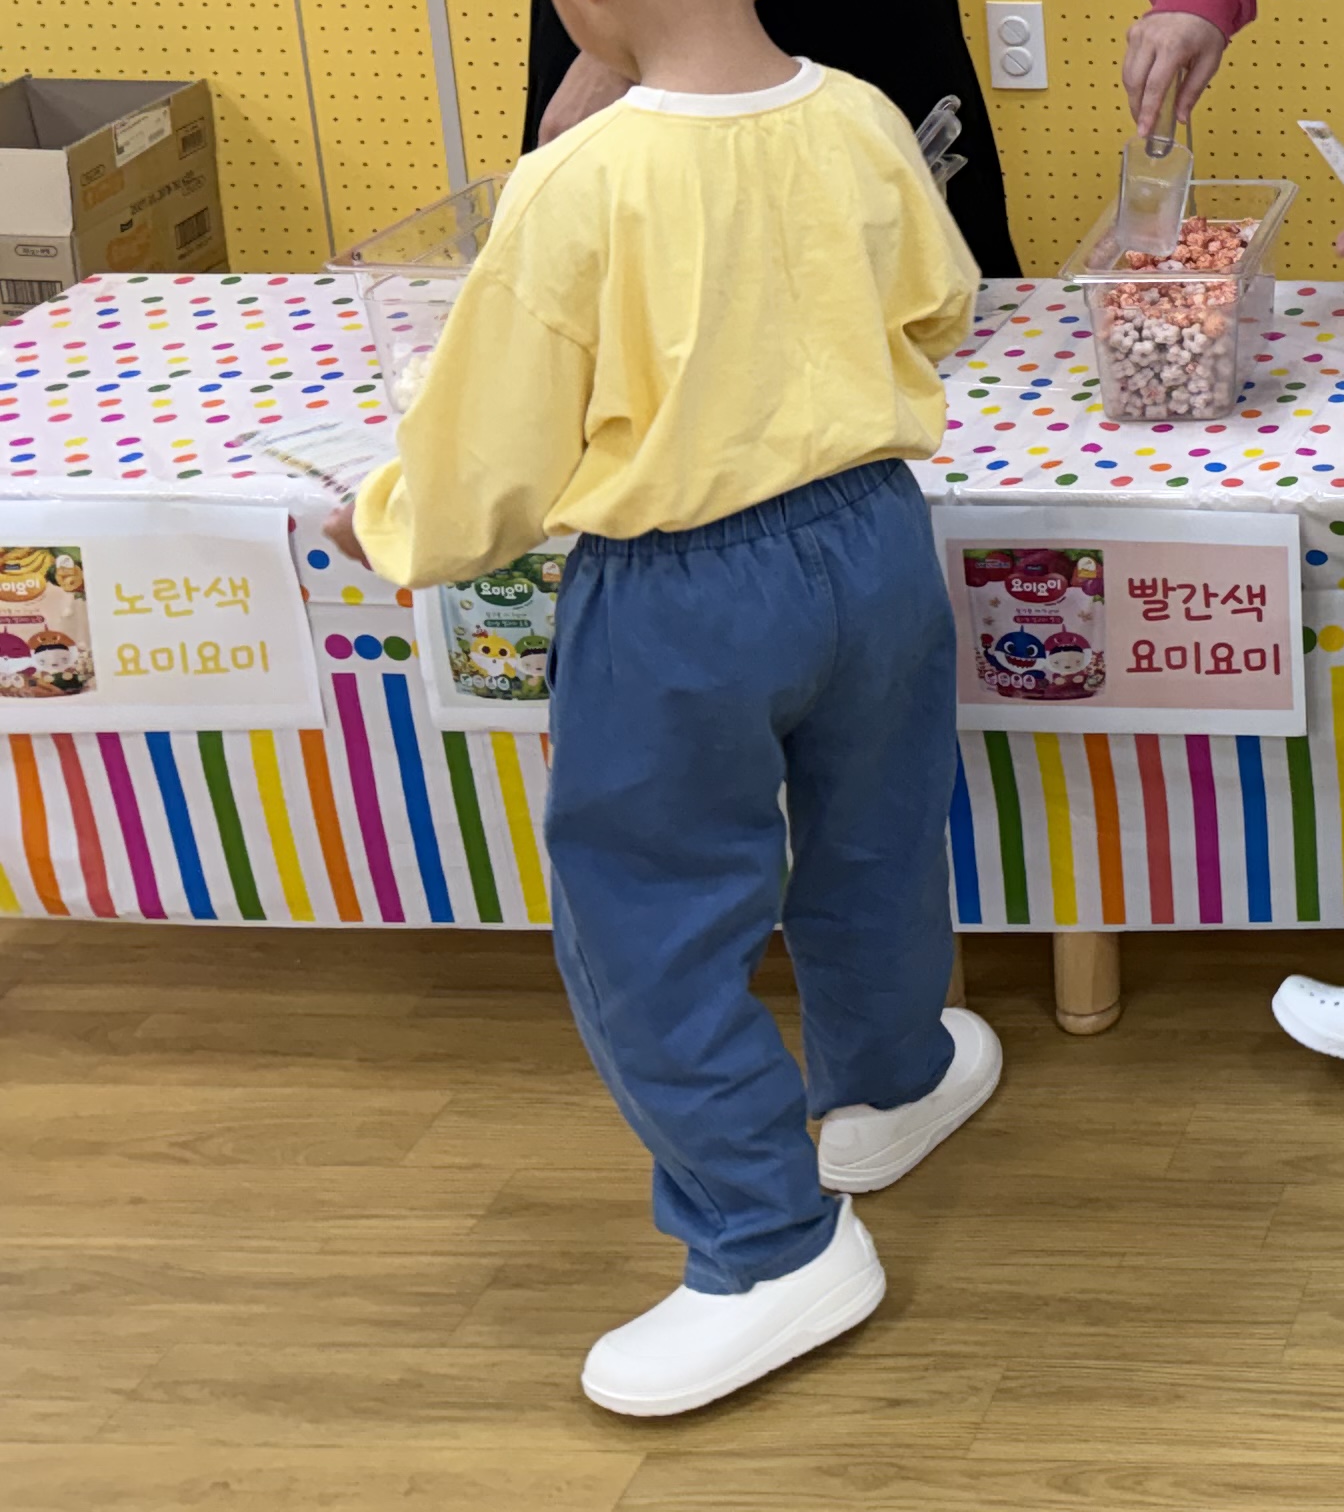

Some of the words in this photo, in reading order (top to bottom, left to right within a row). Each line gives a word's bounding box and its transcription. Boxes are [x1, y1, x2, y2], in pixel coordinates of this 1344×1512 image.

[0, 578, 40, 596] 미요미
[113, 576, 254, 617] 노란색
[480, 581, 528, 600] 요미요미
[1011, 578, 1062, 597] 요미요미
[1127, 576, 1268, 623] 빨간색
[114, 640, 271, 677] 요미요미
[1126, 639, 1281, 676] 요미요미
